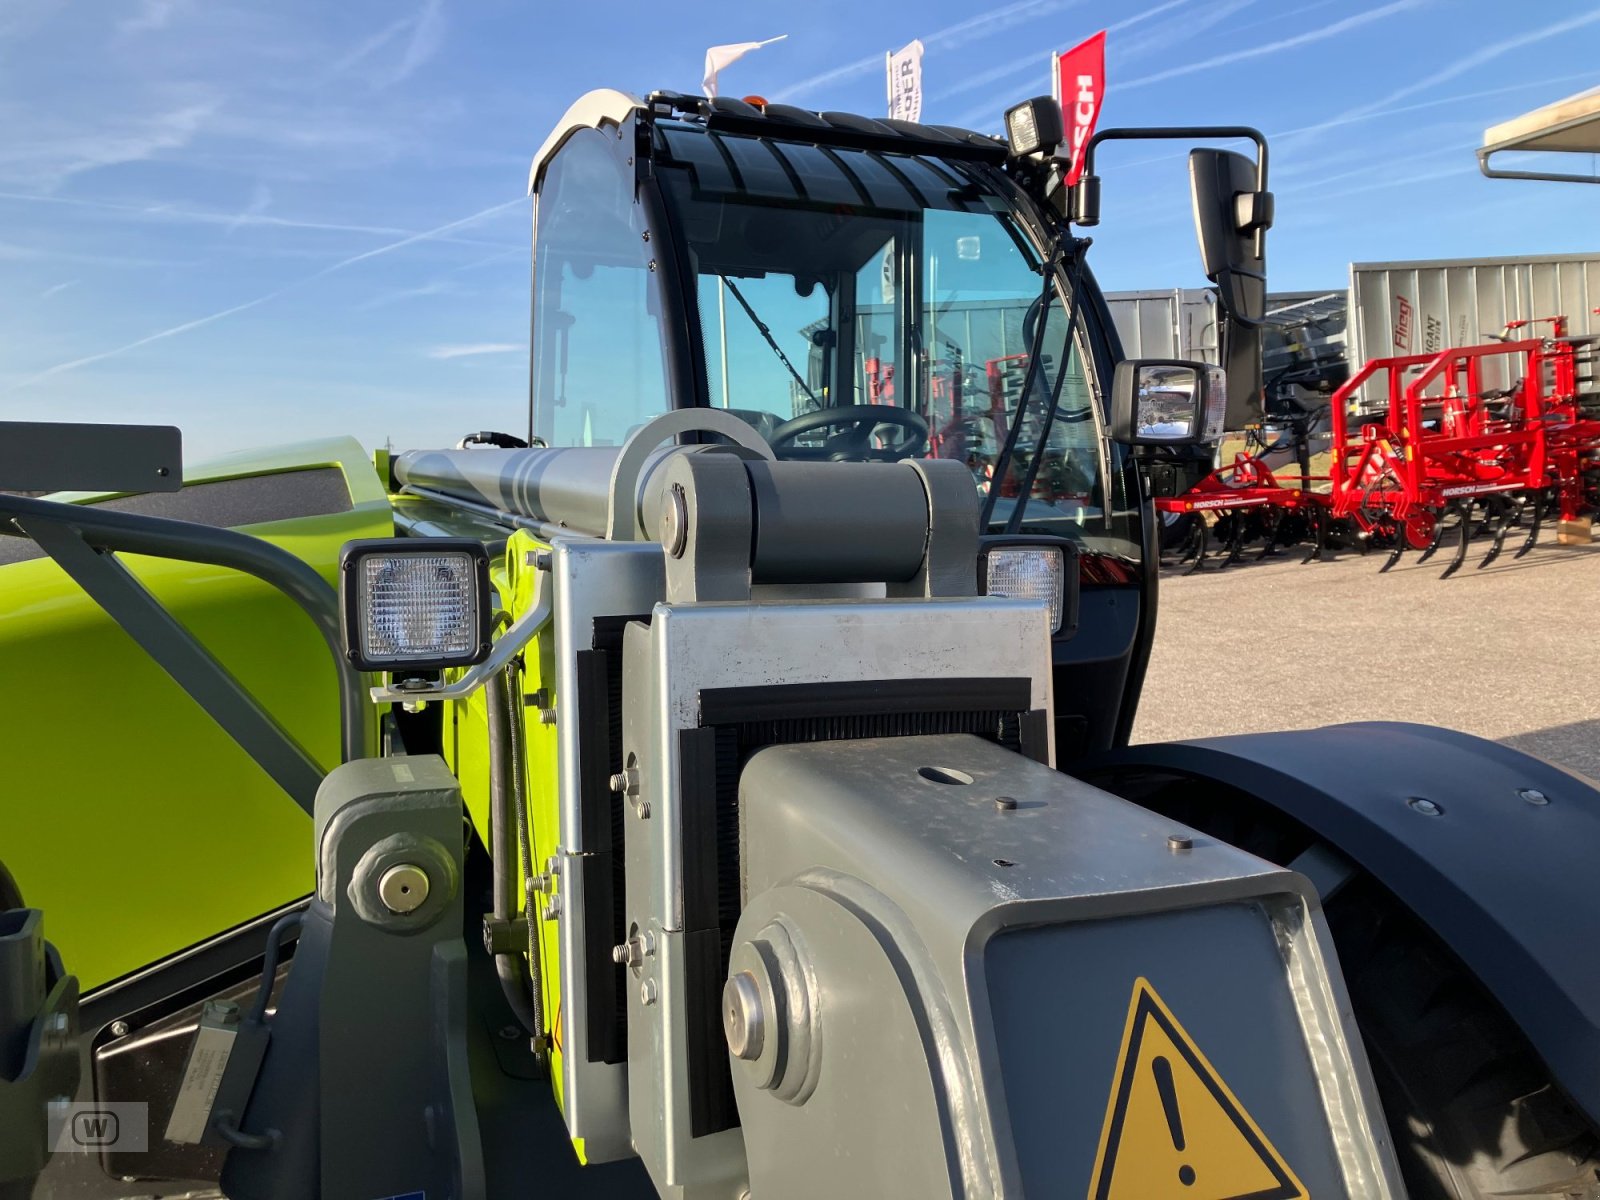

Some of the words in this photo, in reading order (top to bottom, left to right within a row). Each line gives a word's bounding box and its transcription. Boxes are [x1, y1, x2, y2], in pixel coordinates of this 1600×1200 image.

[1395, 296, 1412, 349] Fliegl
[1425, 314, 1436, 354] IGANT
[1193, 499, 1223, 509] HORSCH
[1443, 486, 1475, 497] HORSCH
